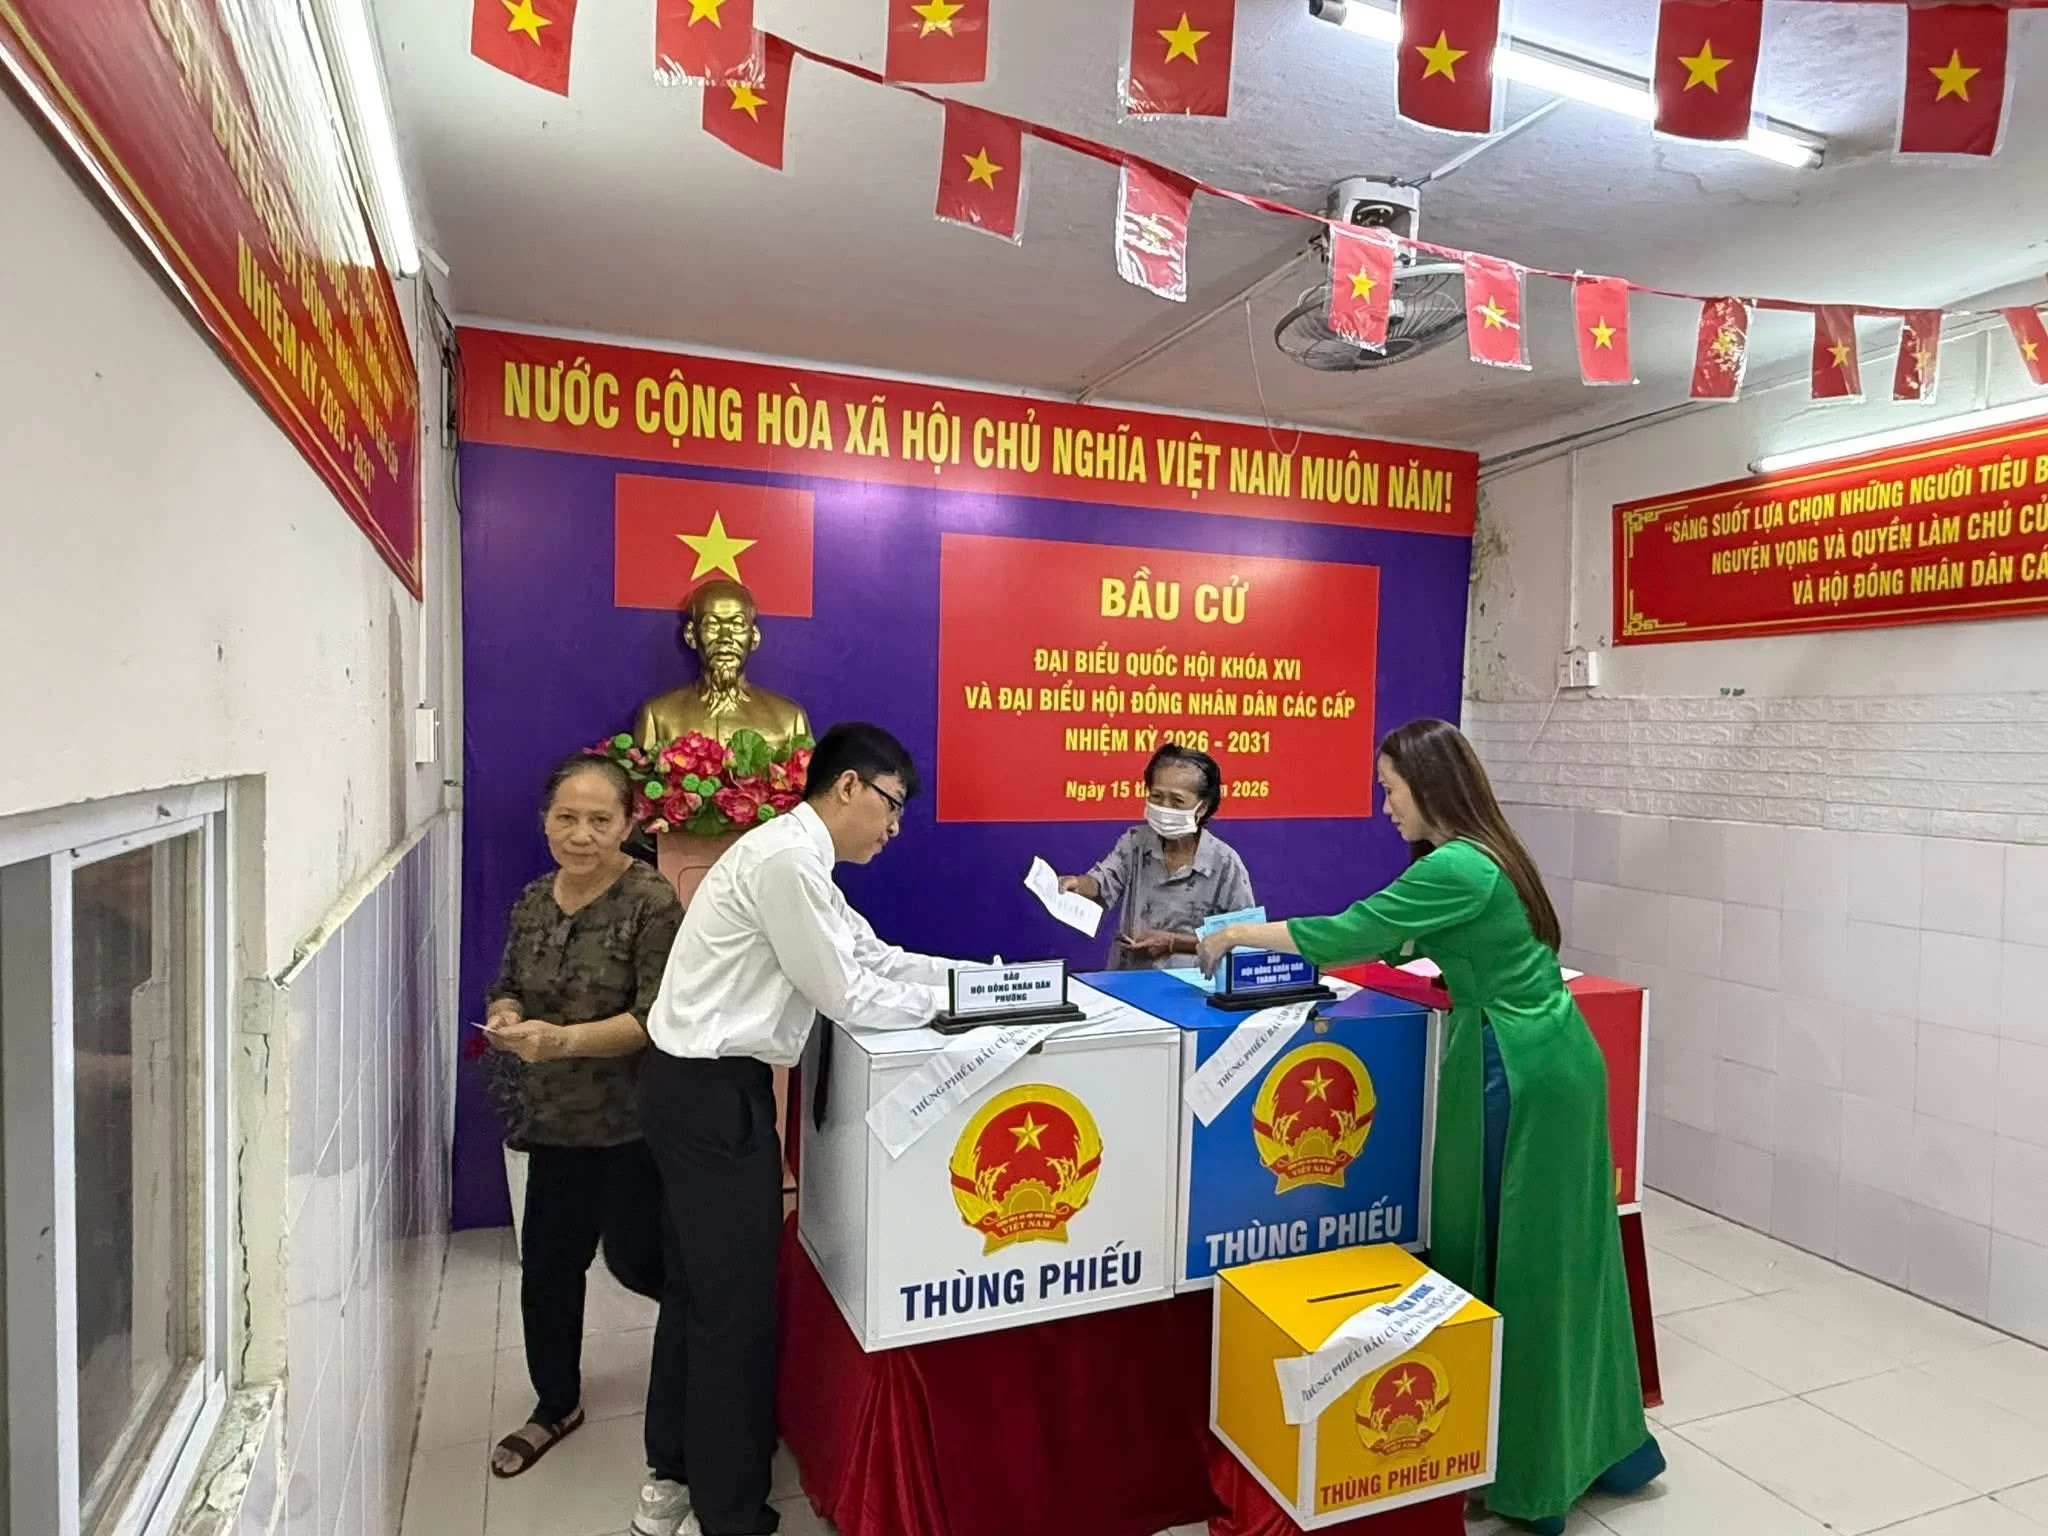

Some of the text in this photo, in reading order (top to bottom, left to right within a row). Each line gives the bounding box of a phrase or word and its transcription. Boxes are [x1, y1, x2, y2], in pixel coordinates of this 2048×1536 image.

[504, 356, 1453, 513] NƯỚC CỘNG HÒA XÃ HỘI CHỦ NGHĨA VIỆT NAM MUÔN NĂM!
[1712, 502, 1750, 537] SUỐT
[1754, 503, 1784, 535] LỰA
[1788, 496, 1834, 526] CHỌN
[1841, 477, 1904, 516] NHỮNG
[1910, 464, 1973, 504] NGƯỜI
[1979, 454, 2028, 493] TIÊU
[1712, 537, 1770, 576] NGUYỆN
[1775, 534, 1818, 569] VỌNG
[1824, 527, 1846, 561] VÀ
[1852, 514, 1912, 558] QUYỀN
[1918, 512, 1961, 548] LÀM
[1967, 500, 2013, 541] CHỦ
[1101, 565, 1251, 624] BẦU CỬ
[1793, 572, 1814, 606] VÀ
[1819, 568, 1848, 608] HỘI
[1854, 561, 1904, 600] ĐỒNG
[1910, 557, 1965, 594] NHÂN
[1971, 551, 2014, 588] DÂN
[1034, 641, 1301, 682] ĐẠI BIỂU QUỐC HỘI KHÓA XVI
[965, 679, 1356, 719] VÀ ĐẠI BIỂU HỘI ĐỒNG NHÂN DÂN CÁC CẤP
[1065, 723, 1129, 755] NHIỆM
[1134, 724, 1158, 752] KỲ
[1163, 729, 1209, 753] 2026
[1228, 730, 1271, 753] 2031
[1066, 778, 1105, 801] Ngày
[1112, 780, 1130, 798] 15
[1232, 781, 1270, 798] 2026
[1205, 1195, 1403, 1268] THÙNG PHIẾU
[900, 1240, 1142, 1321] THÙNG PHIẾU
[1320, 1450, 1481, 1506] THÙNG PHIẾU PHỤ
